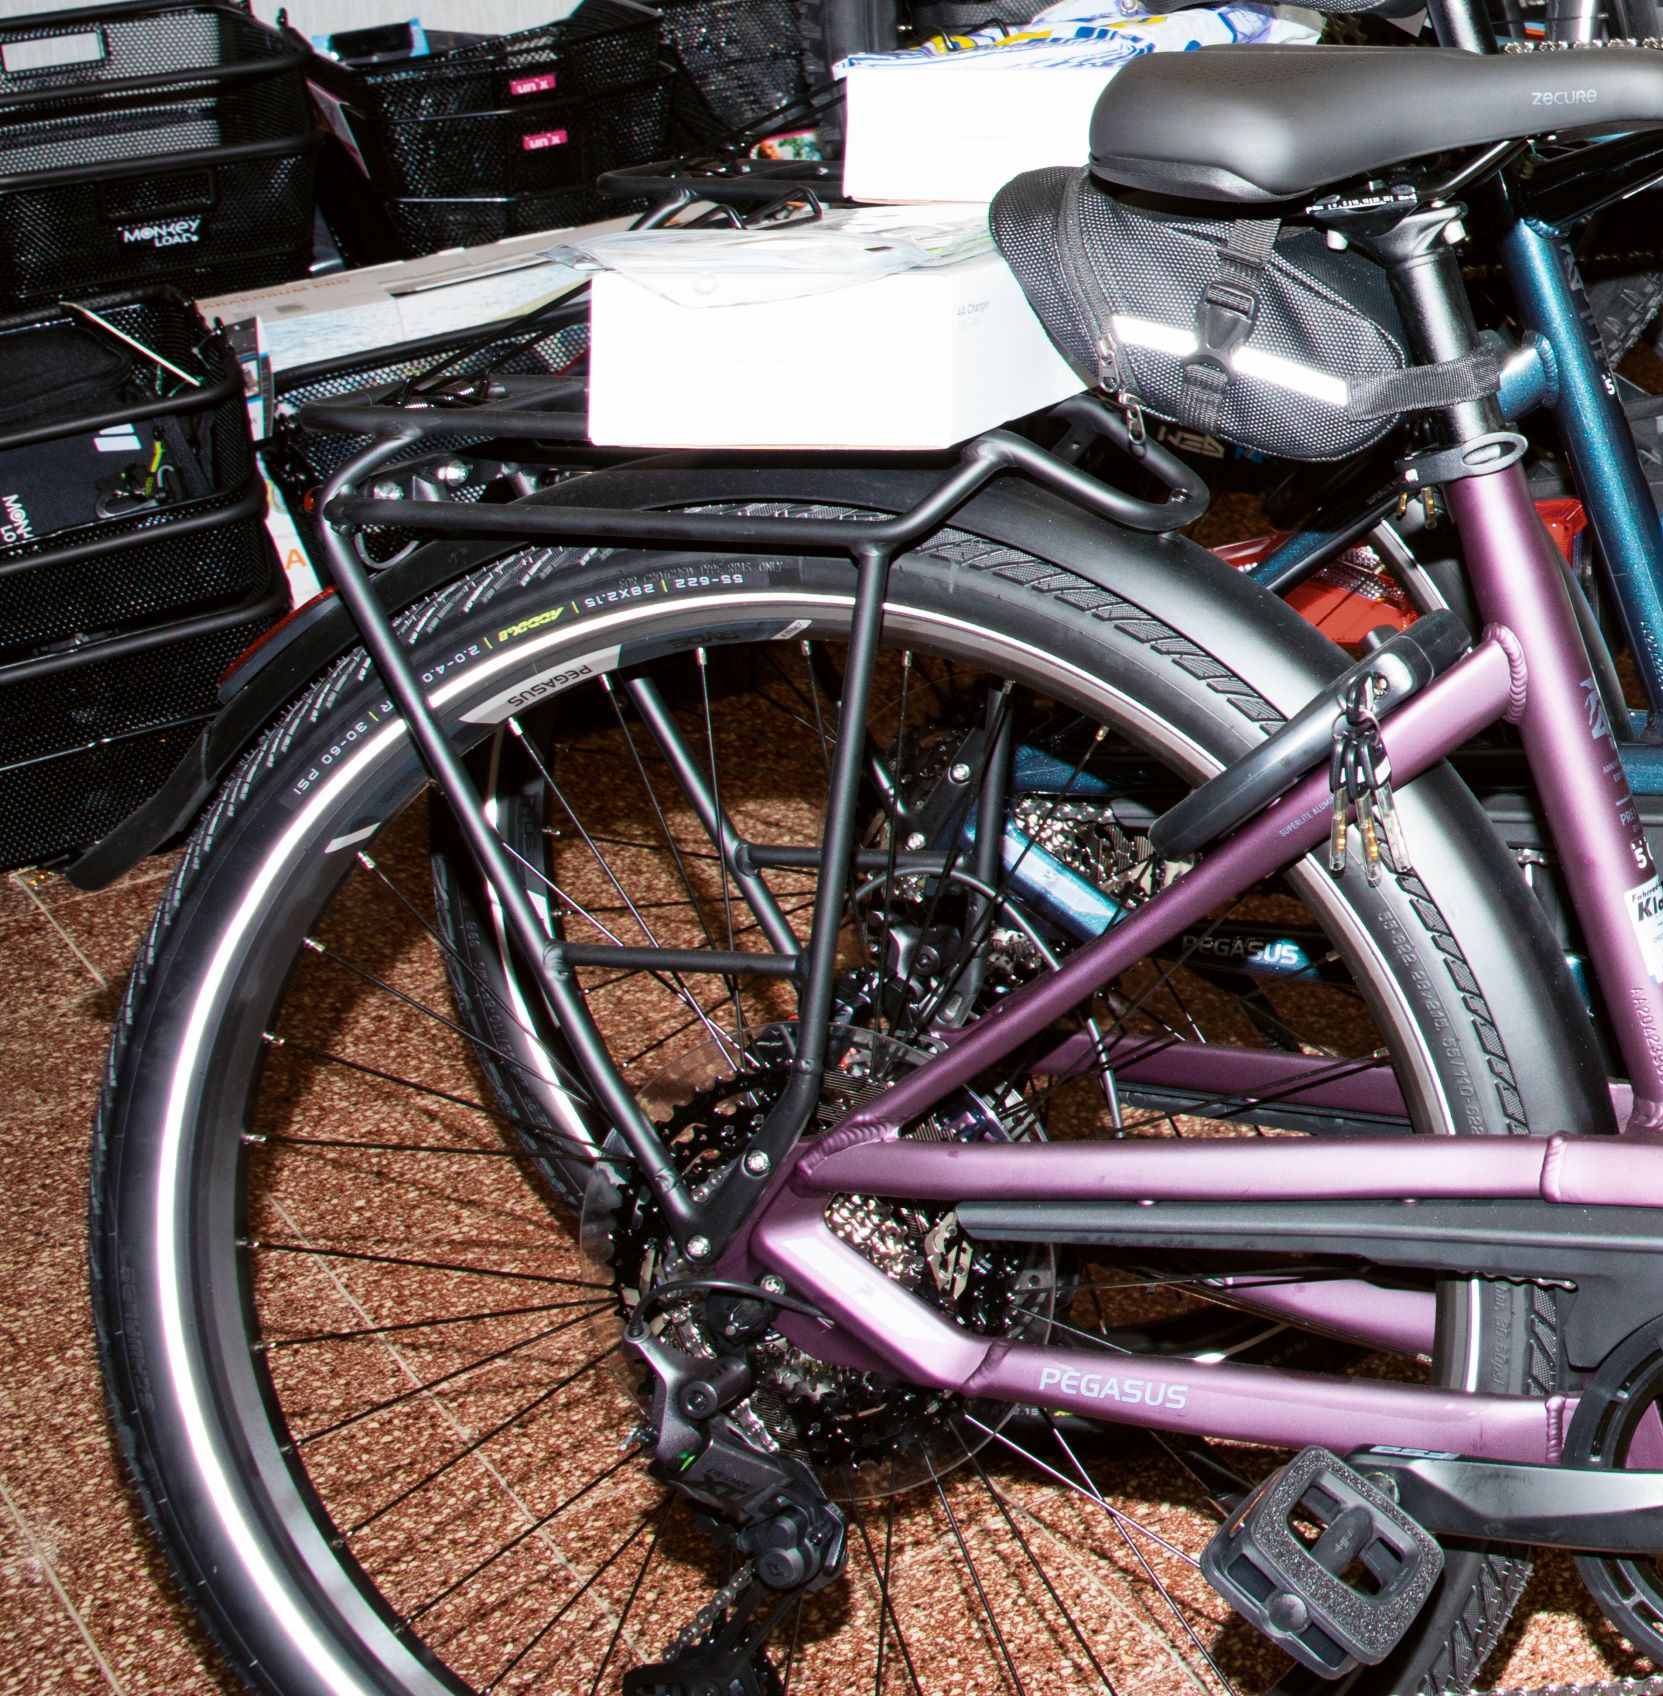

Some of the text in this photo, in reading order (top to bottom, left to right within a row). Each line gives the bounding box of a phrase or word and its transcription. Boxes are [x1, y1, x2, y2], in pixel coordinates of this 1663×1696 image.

[1531, 89, 1598, 106] zecure
[124, 219, 201, 243] MONKEY
[285, 547, 307, 571] A
[584, 580, 655, 610] 28X2.15
[674, 572, 745, 589] 55-622
[419, 642, 482, 684] 2.0-4.0
[507, 663, 594, 708] PEGASUS
[292, 720, 369, 796] 30-60 PSI
[1278, 807, 1313, 838] SUPERLITE
[1182, 935, 1300, 965] PEGASUS
[1038, 1366, 1189, 1410] PEGASUS
